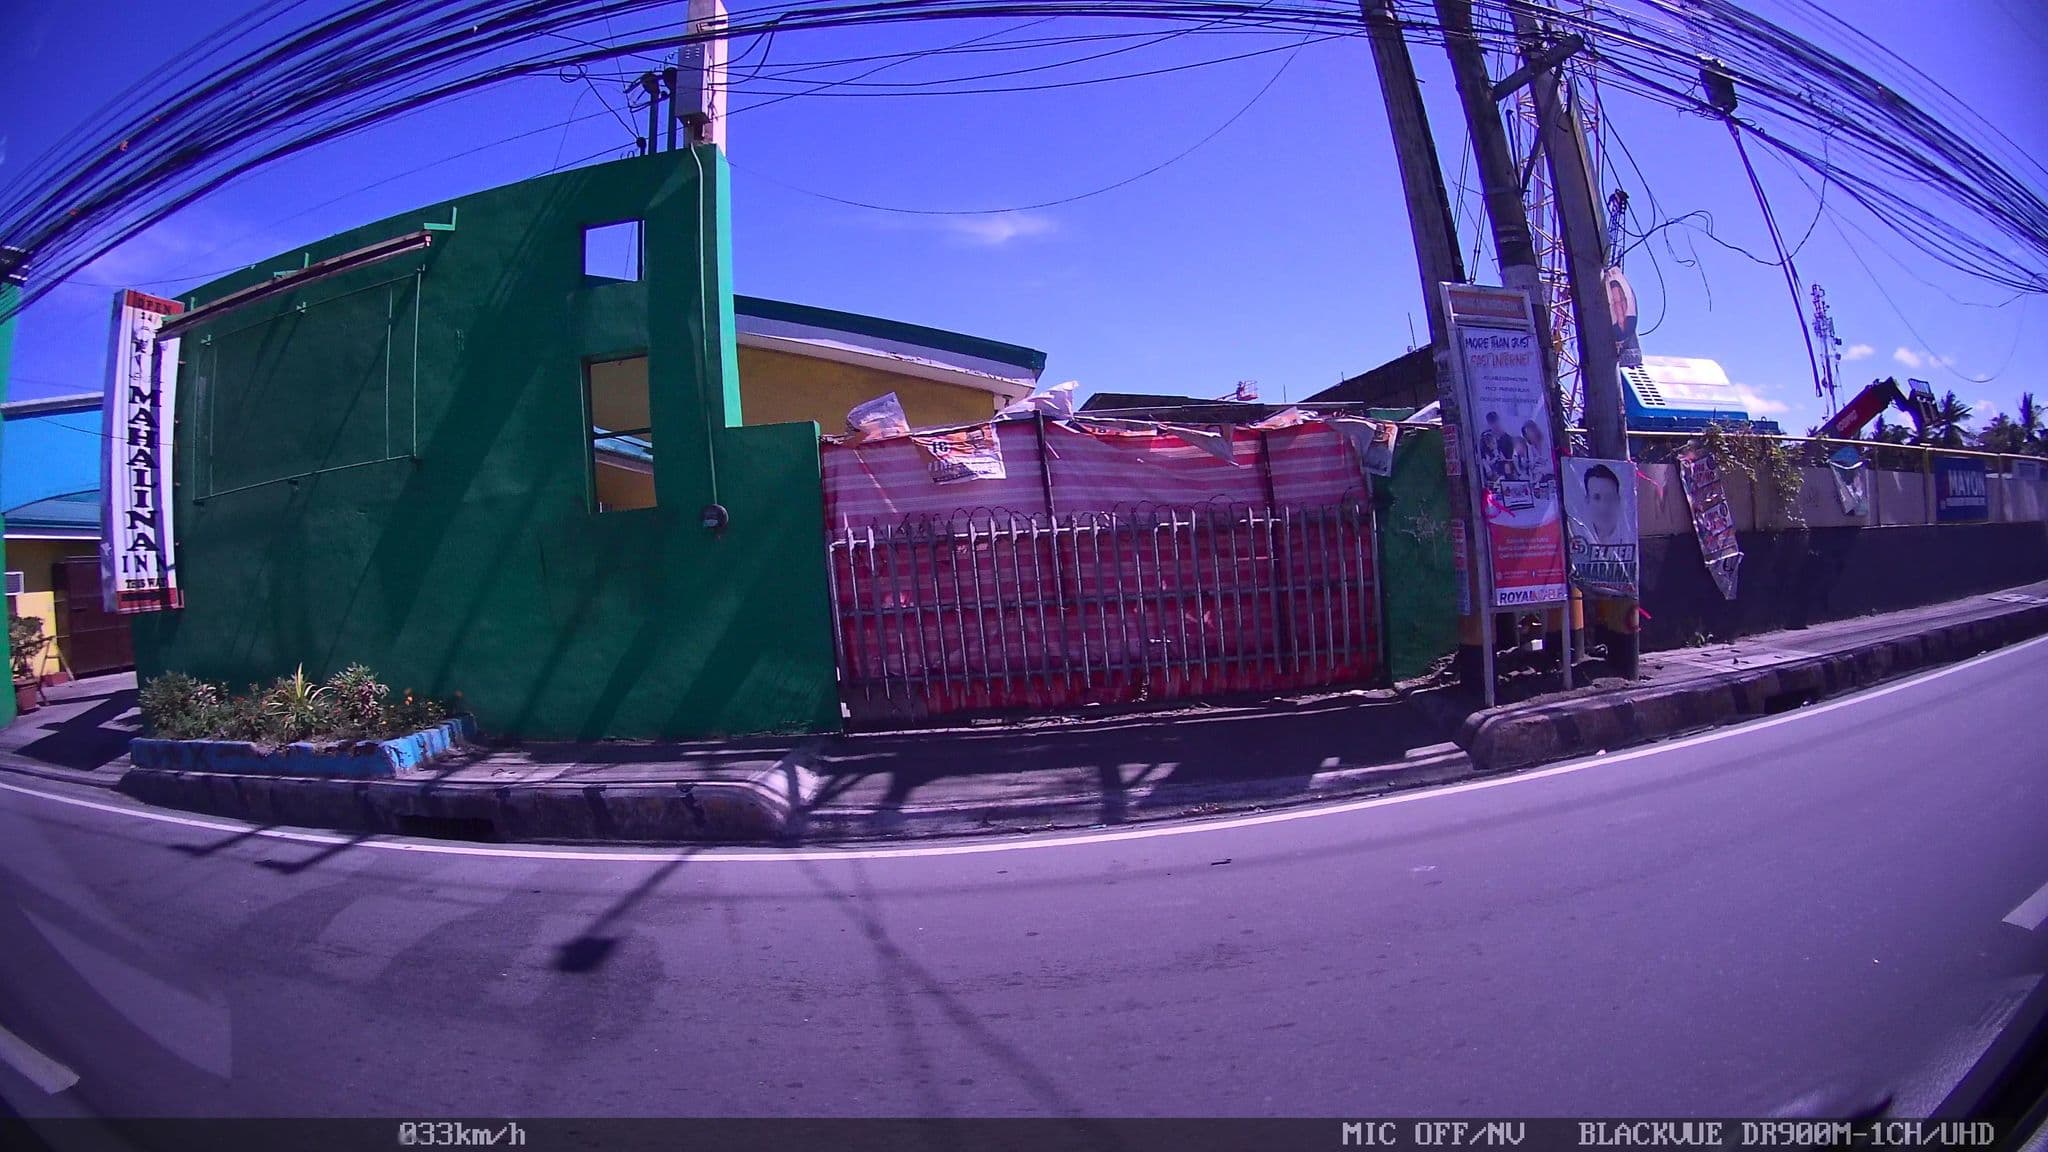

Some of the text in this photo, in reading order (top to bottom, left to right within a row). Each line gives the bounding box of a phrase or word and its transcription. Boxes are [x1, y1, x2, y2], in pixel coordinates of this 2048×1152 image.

[1465, 336, 1531, 350] MORE THAN JUST
[1947, 469, 1986, 496] MAYON
[1590, 545, 1634, 561] ELMER
[122, 555, 167, 573] INN
